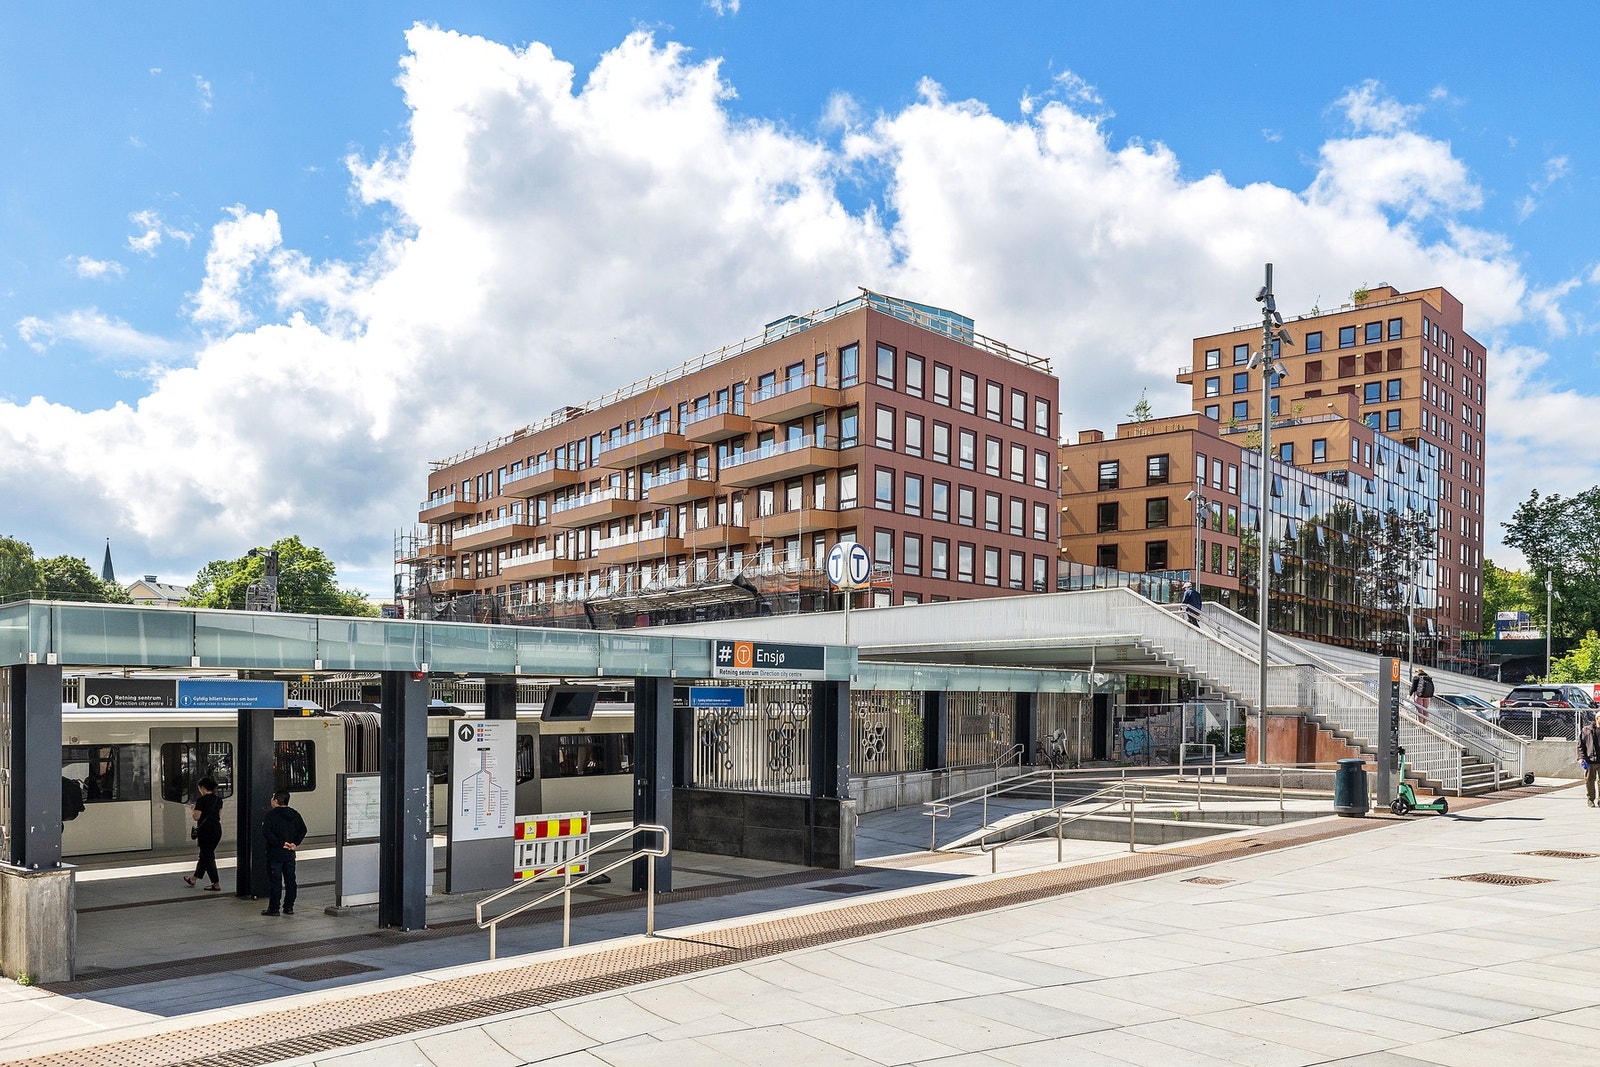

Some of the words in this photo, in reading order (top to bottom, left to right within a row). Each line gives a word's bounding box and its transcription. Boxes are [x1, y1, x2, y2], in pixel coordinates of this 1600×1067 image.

[832, 554, 841, 577] T
[853, 554, 864, 577] T
[757, 649, 785, 665] Ensjø
[719, 668, 738, 676] Retning
[760, 669, 780, 677] Direction
